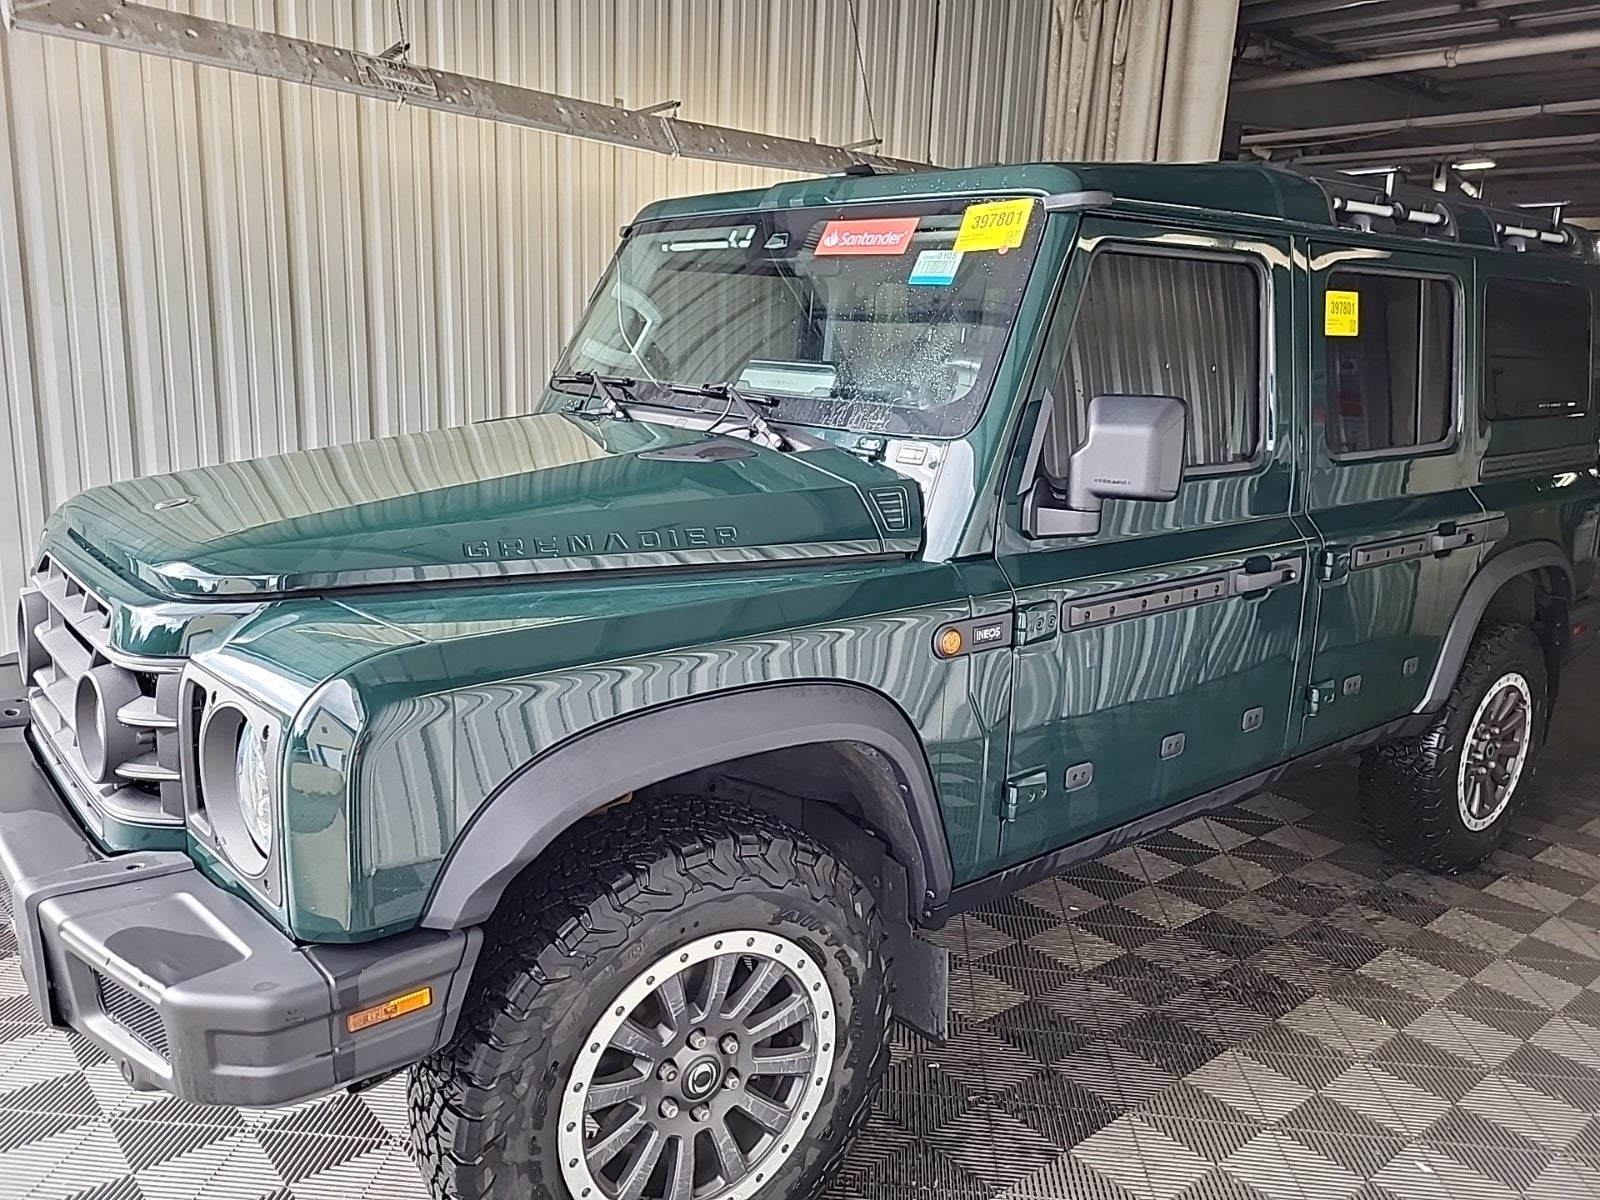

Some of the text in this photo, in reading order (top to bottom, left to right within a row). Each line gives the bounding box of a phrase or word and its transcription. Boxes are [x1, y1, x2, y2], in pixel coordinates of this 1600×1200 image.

[971, 211, 1023, 230] 397801
[839, 230, 904, 247] Santander
[1331, 300, 1355, 315] 397801
[463, 526, 738, 558] GRENADIER
[976, 626, 1001, 641] INEOS
